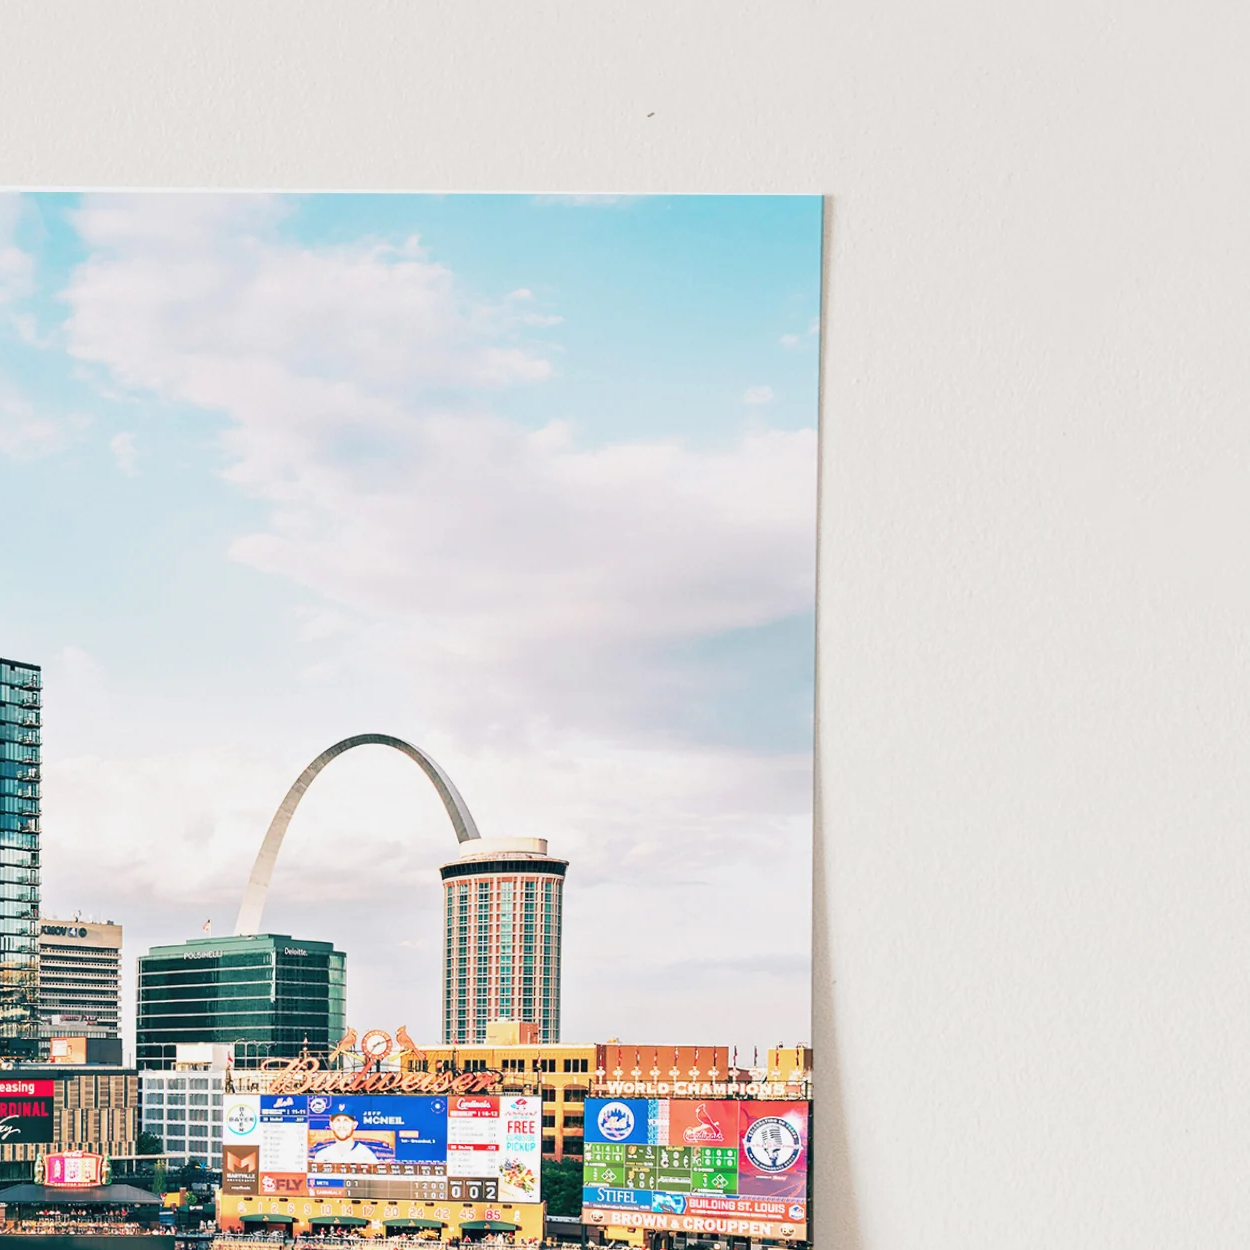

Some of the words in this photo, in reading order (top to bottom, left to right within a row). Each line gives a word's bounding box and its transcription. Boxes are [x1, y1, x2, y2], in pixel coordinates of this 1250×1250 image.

[41, 925, 67, 936] KMOV
[260, 1057, 503, 1094] Budweiser
[607, 1081, 669, 1095] WORLD
[674, 1081, 786, 1096] CHAMPIONS
[457, 1098, 491, 1110] Cardinals
[363, 1116, 405, 1125] MCNEIL
[507, 1120, 535, 1134] FREE
[506, 1142, 536, 1152] PICKUP
[276, 1179, 303, 1190] FLY
[451, 1186, 461, 1199] 0
[469, 1186, 479, 1199] 0
[486, 1186, 496, 1199] 2
[597, 1187, 638, 1204] STIFEL
[321, 1204, 332, 1216] 10
[341, 1204, 354, 1217] 14
[363, 1204, 375, 1217] 17
[384, 1205, 400, 1217] 20
[408, 1206, 424, 1219] 24
[434, 1207, 450, 1219] 42
[459, 1208, 475, 1220] 45
[485, 1209, 500, 1221] 85
[689, 1200, 737, 1211] BUILDING
[738, 1202, 753, 1212] ST.
[755, 1203, 785, 1214] LOUIS
[611, 1213, 668, 1228] BROWN
[670, 1219, 680, 1229] &
[683, 1216, 772, 1236] CROUPPEN
